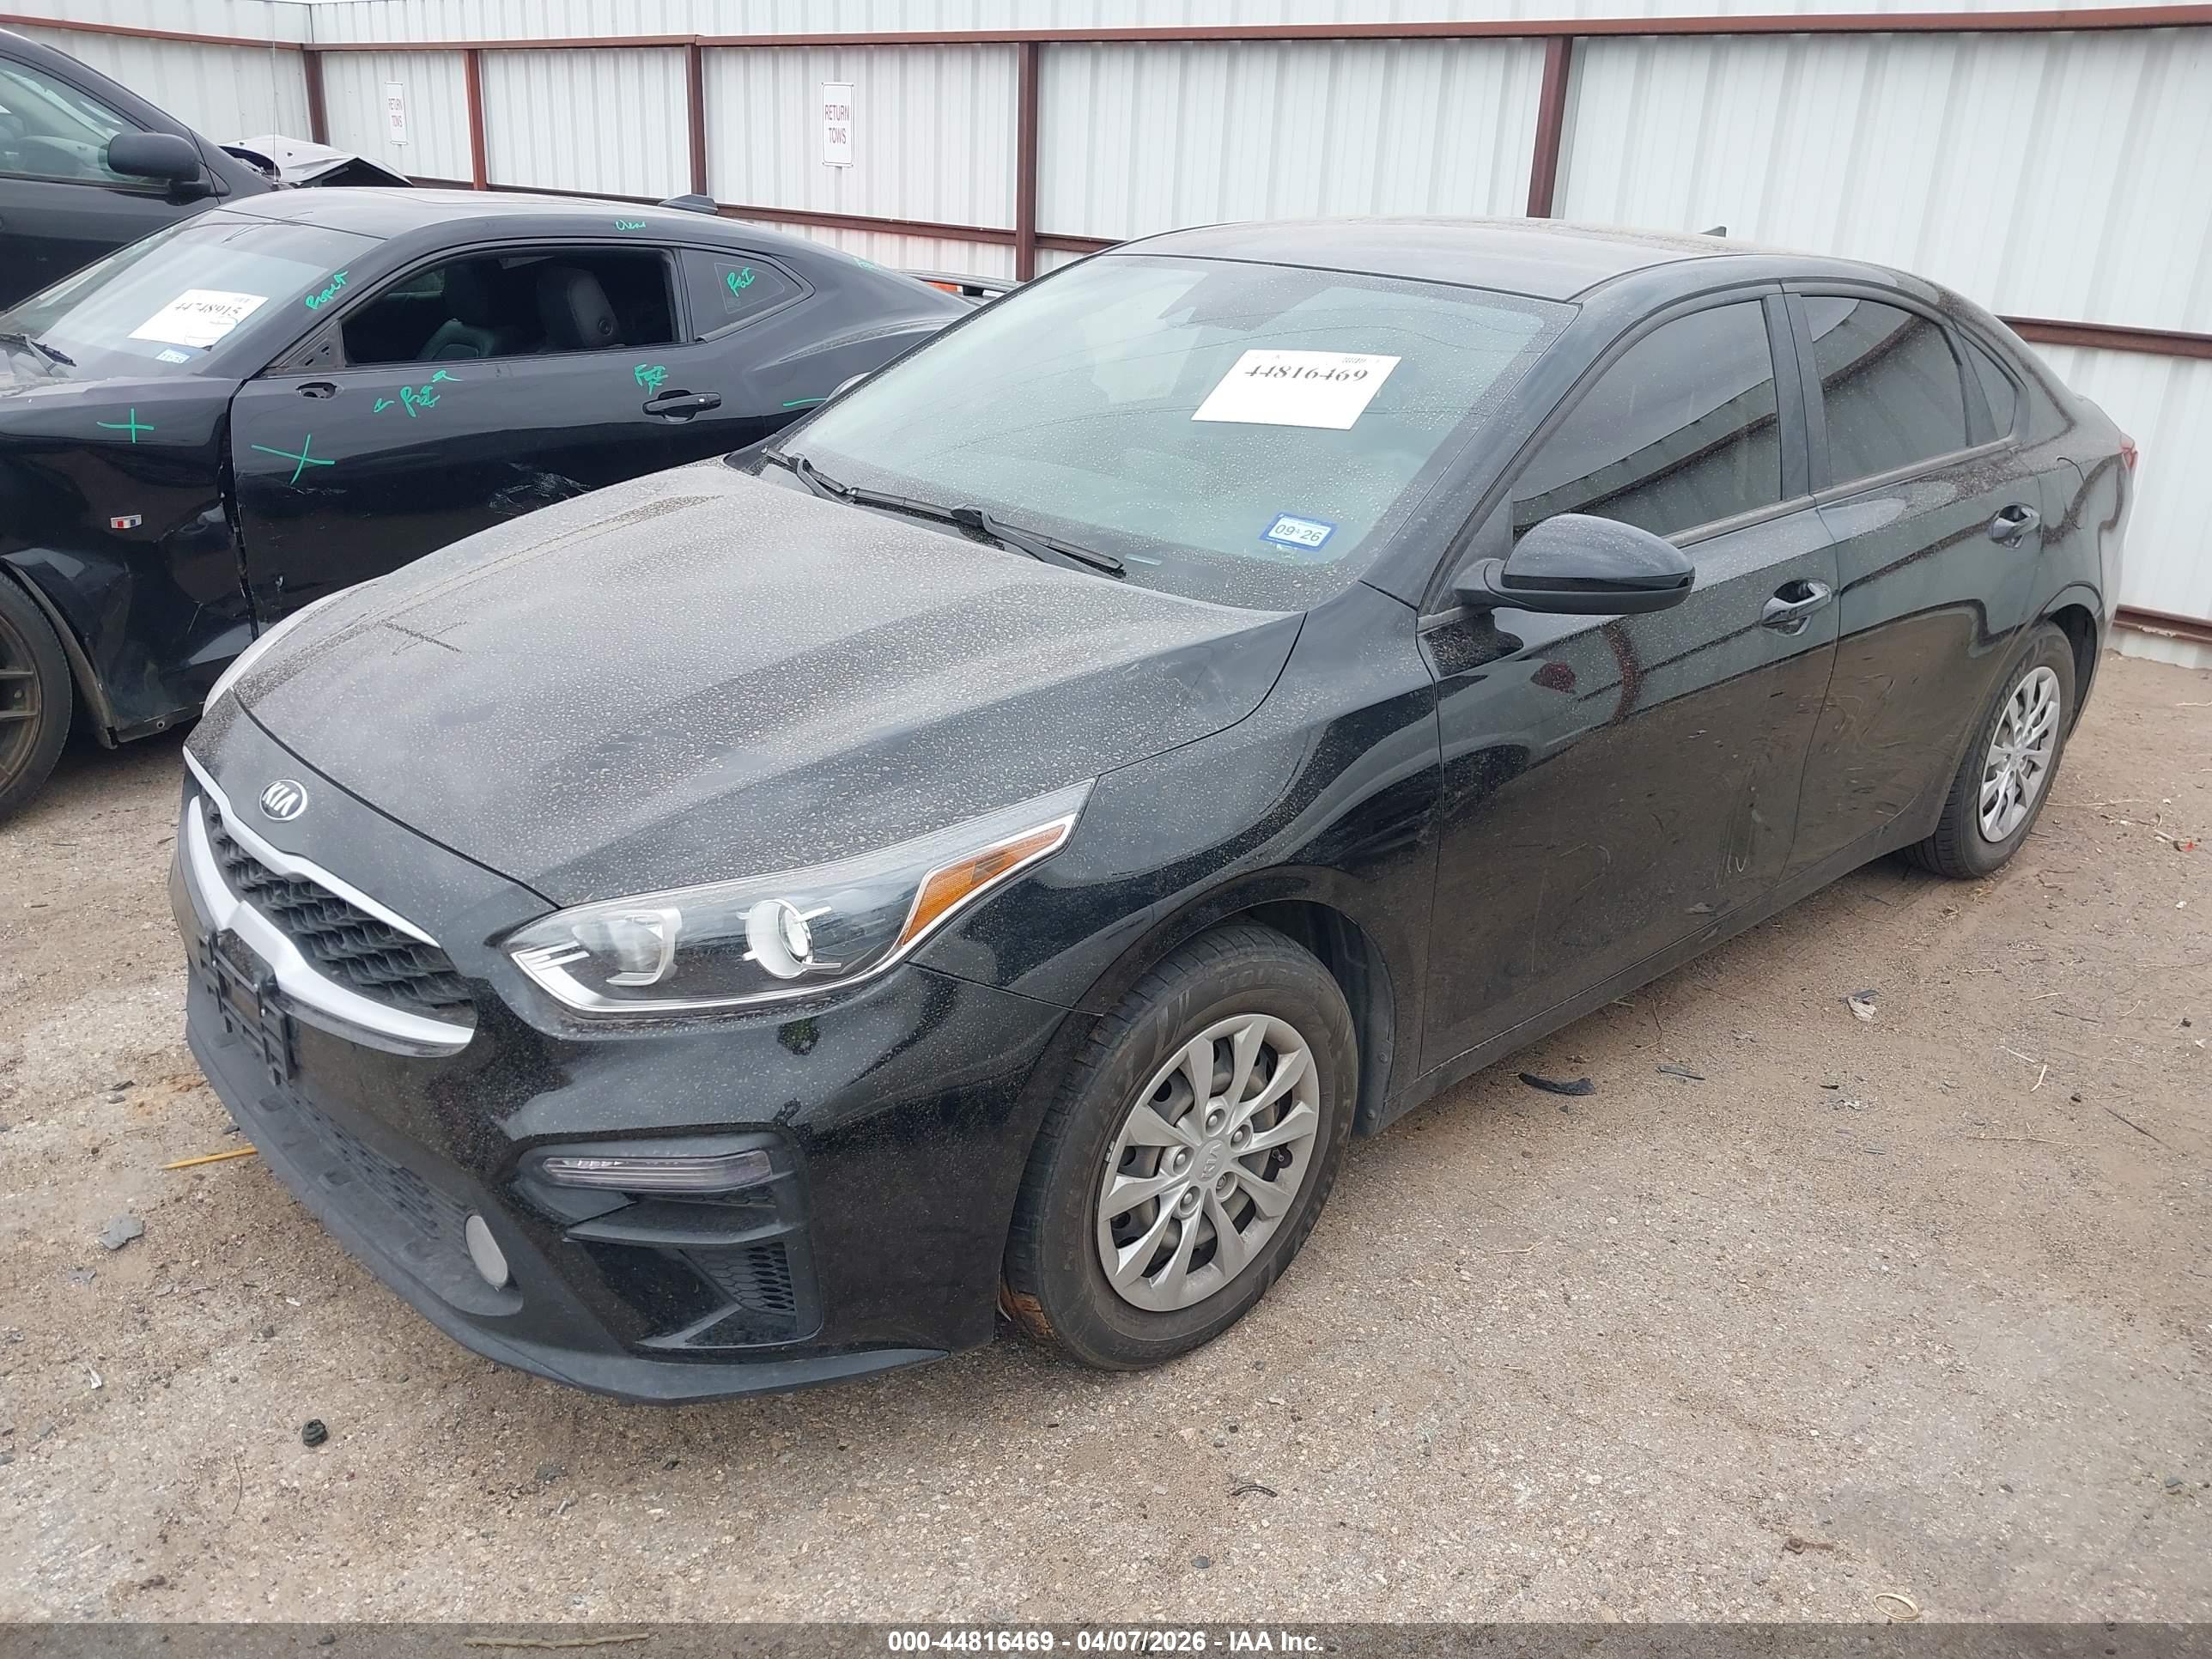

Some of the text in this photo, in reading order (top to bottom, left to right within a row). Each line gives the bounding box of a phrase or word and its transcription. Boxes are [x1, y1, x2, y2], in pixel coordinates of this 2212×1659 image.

[824, 104, 850, 121] RETURN
[829, 127, 847, 144] TOWS
[1244, 364, 1368, 381] 44816469
[261, 781, 299, 817] KIA
